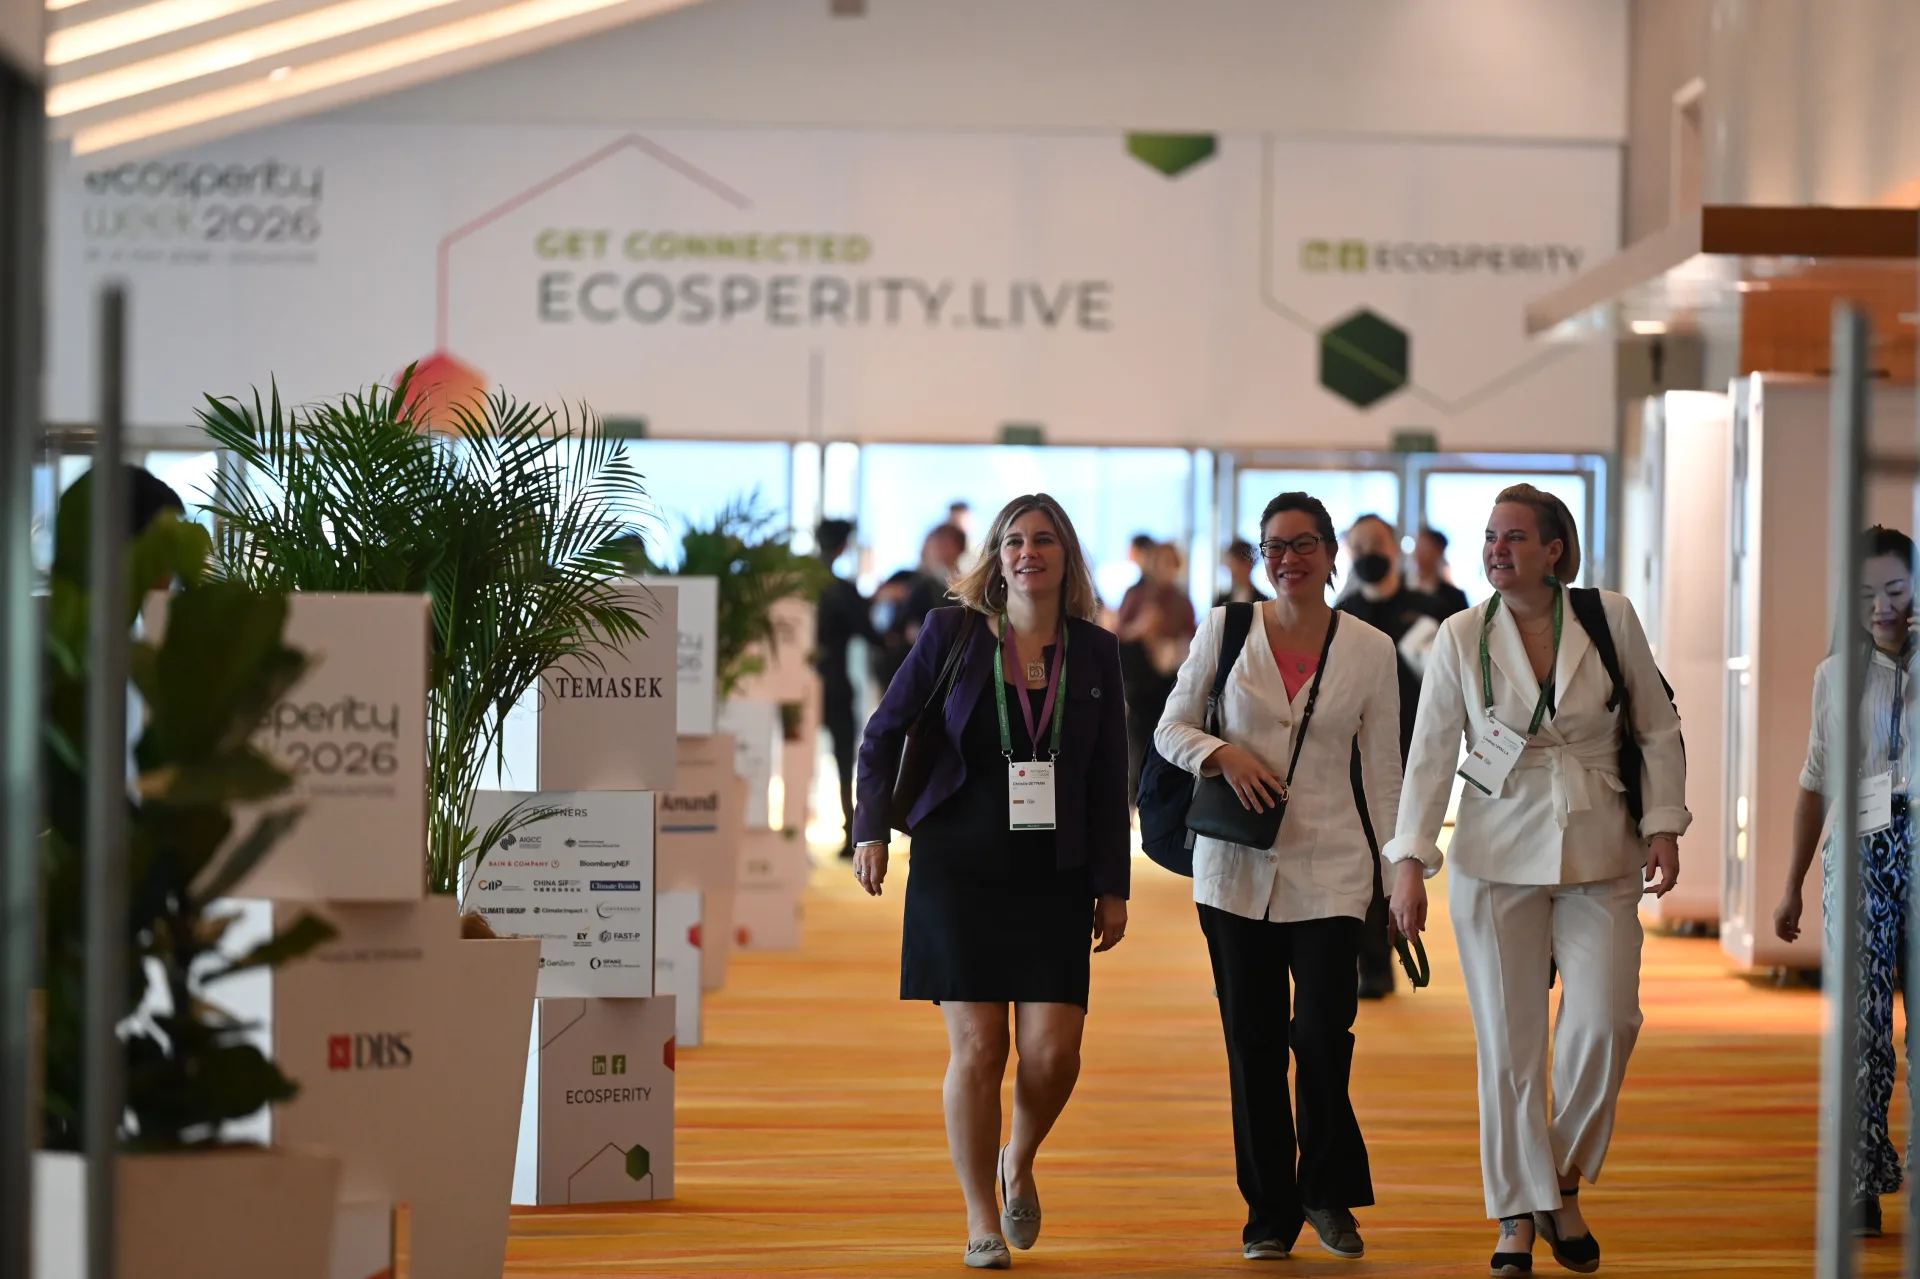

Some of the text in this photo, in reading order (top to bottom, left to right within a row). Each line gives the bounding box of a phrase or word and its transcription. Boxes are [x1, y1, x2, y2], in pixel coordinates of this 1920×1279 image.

[202, 203, 322, 243] 2026
[534, 229, 873, 264] GET CONNECTED
[1374, 241, 1584, 275] ECOSPERITY
[537, 271, 1115, 331] ECOSPERITY.LIVE
[556, 677, 663, 698] TEMASEK
[532, 808, 588, 818] PARTNERS
[579, 860, 630, 869] BloombergNEF
[577, 932, 588, 940] EY
[613, 932, 641, 940] FAST-P
[566, 1086, 652, 1104] ECOSPERITY
